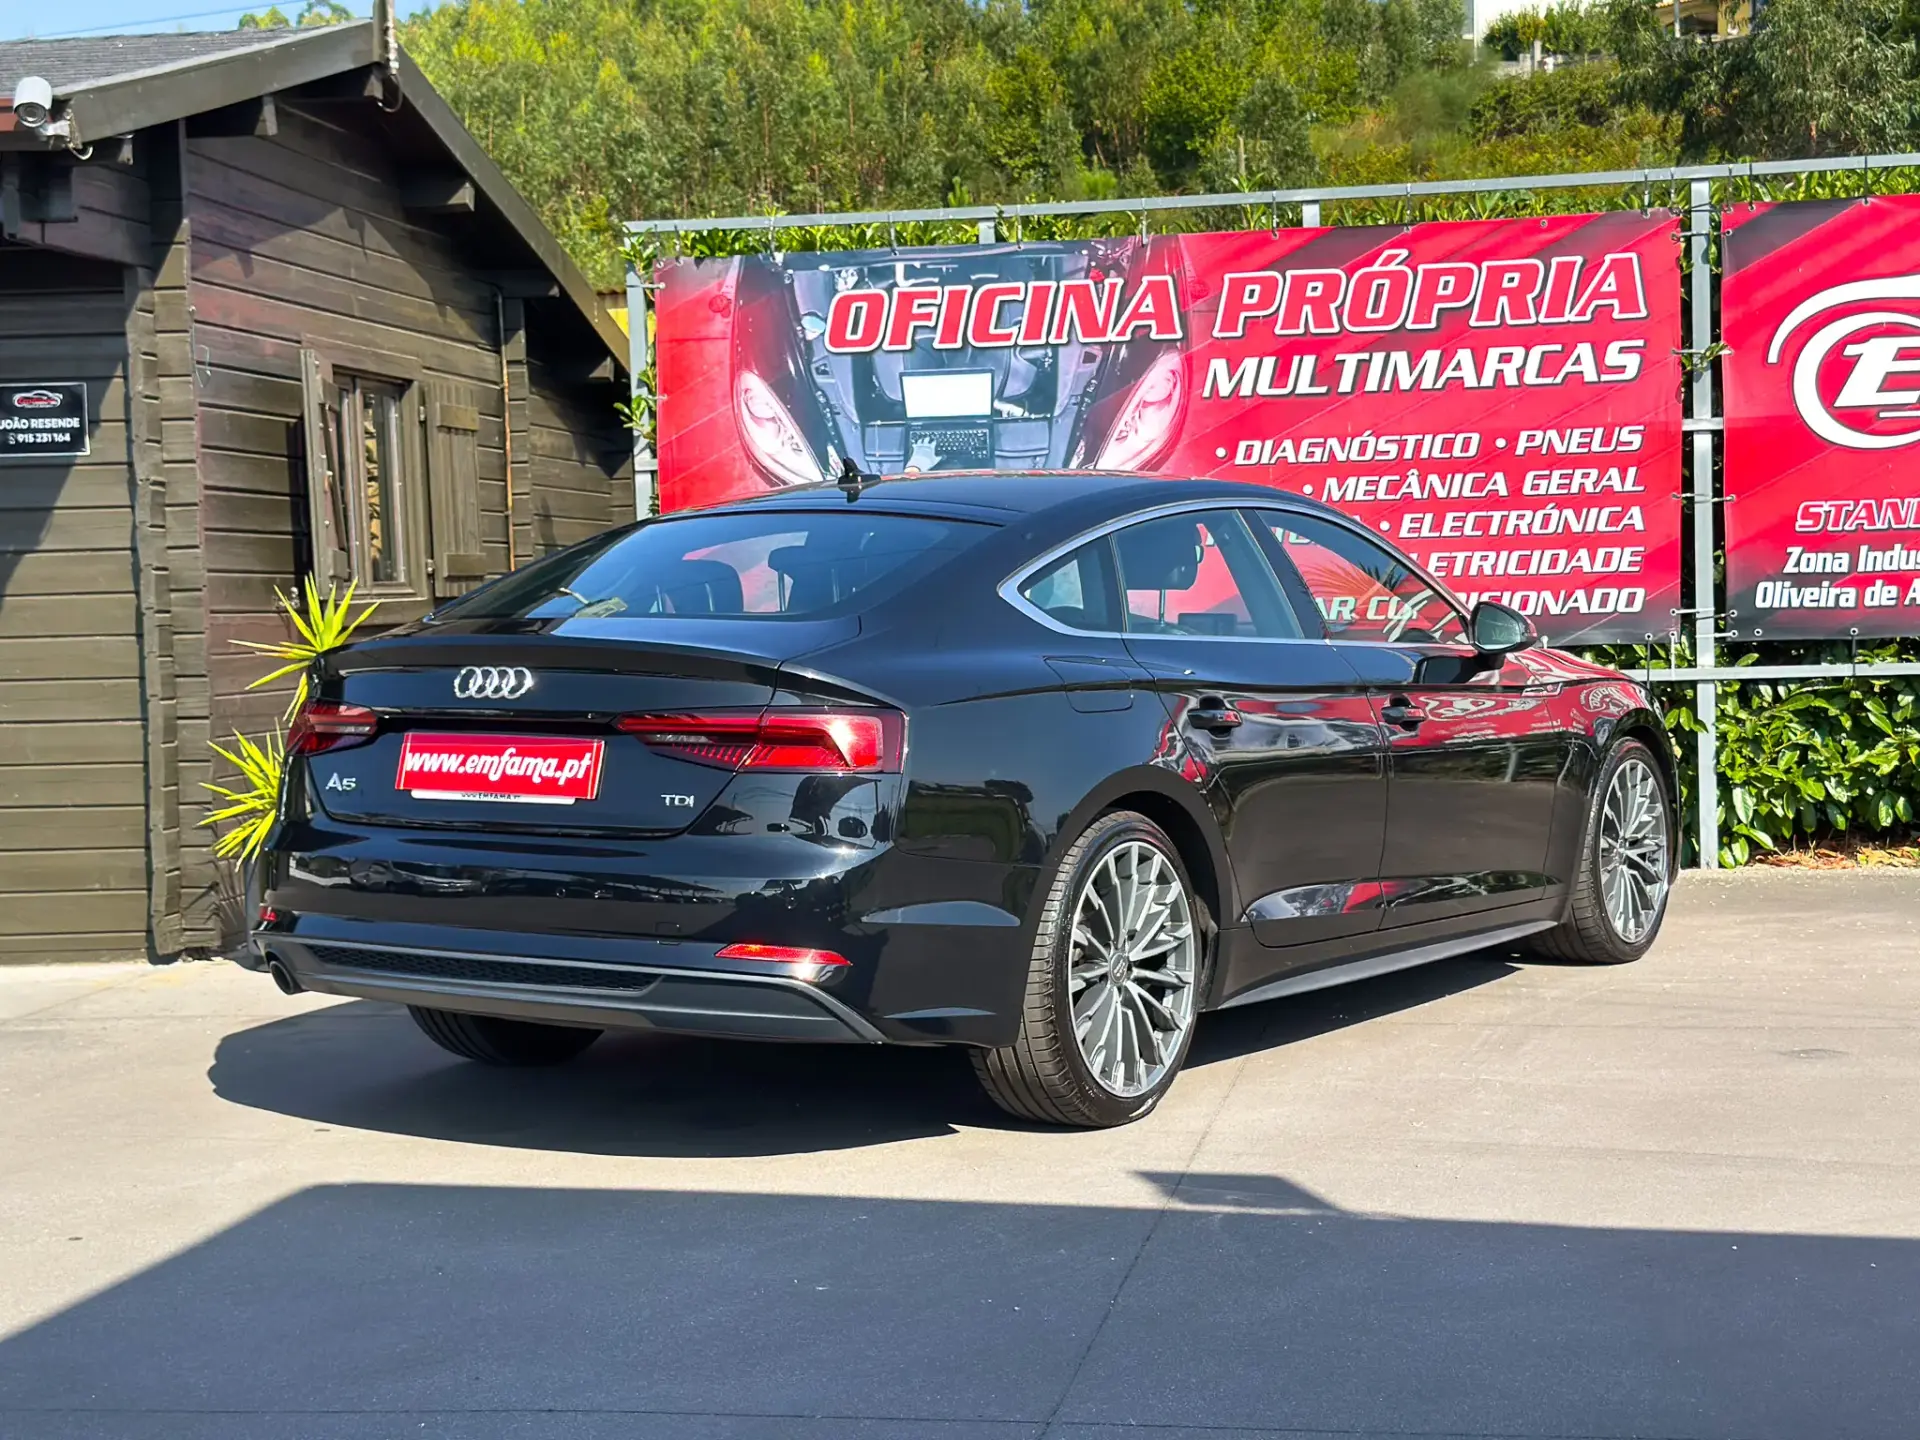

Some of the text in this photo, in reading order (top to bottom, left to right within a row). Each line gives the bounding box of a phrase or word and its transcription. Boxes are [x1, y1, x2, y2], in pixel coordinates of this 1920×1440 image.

[824, 249, 1648, 353] OFICINA PRÓPRIA
[1201, 338, 1646, 400] MULTIMARCAS
[30, 417, 80, 429] RESENDE
[1234, 429, 1482, 466] DIAGNÓSTICO
[1514, 425, 1646, 457] PNEUS
[1322, 466, 1646, 504] MECÂNICA GERAL
[1398, 504, 1646, 540] ELECTRÓNICA
[1794, 498, 1920, 532] STAN
[1409, 546, 1645, 579] ETRICIDADE
[1782, 546, 1850, 574] Zona
[1754, 580, 1857, 609] Oliveira
[1863, 579, 1898, 608] de
[325, 772, 356, 791] A5
[405, 747, 592, 786] www.emfama.pt
[660, 794, 695, 808] TDI
